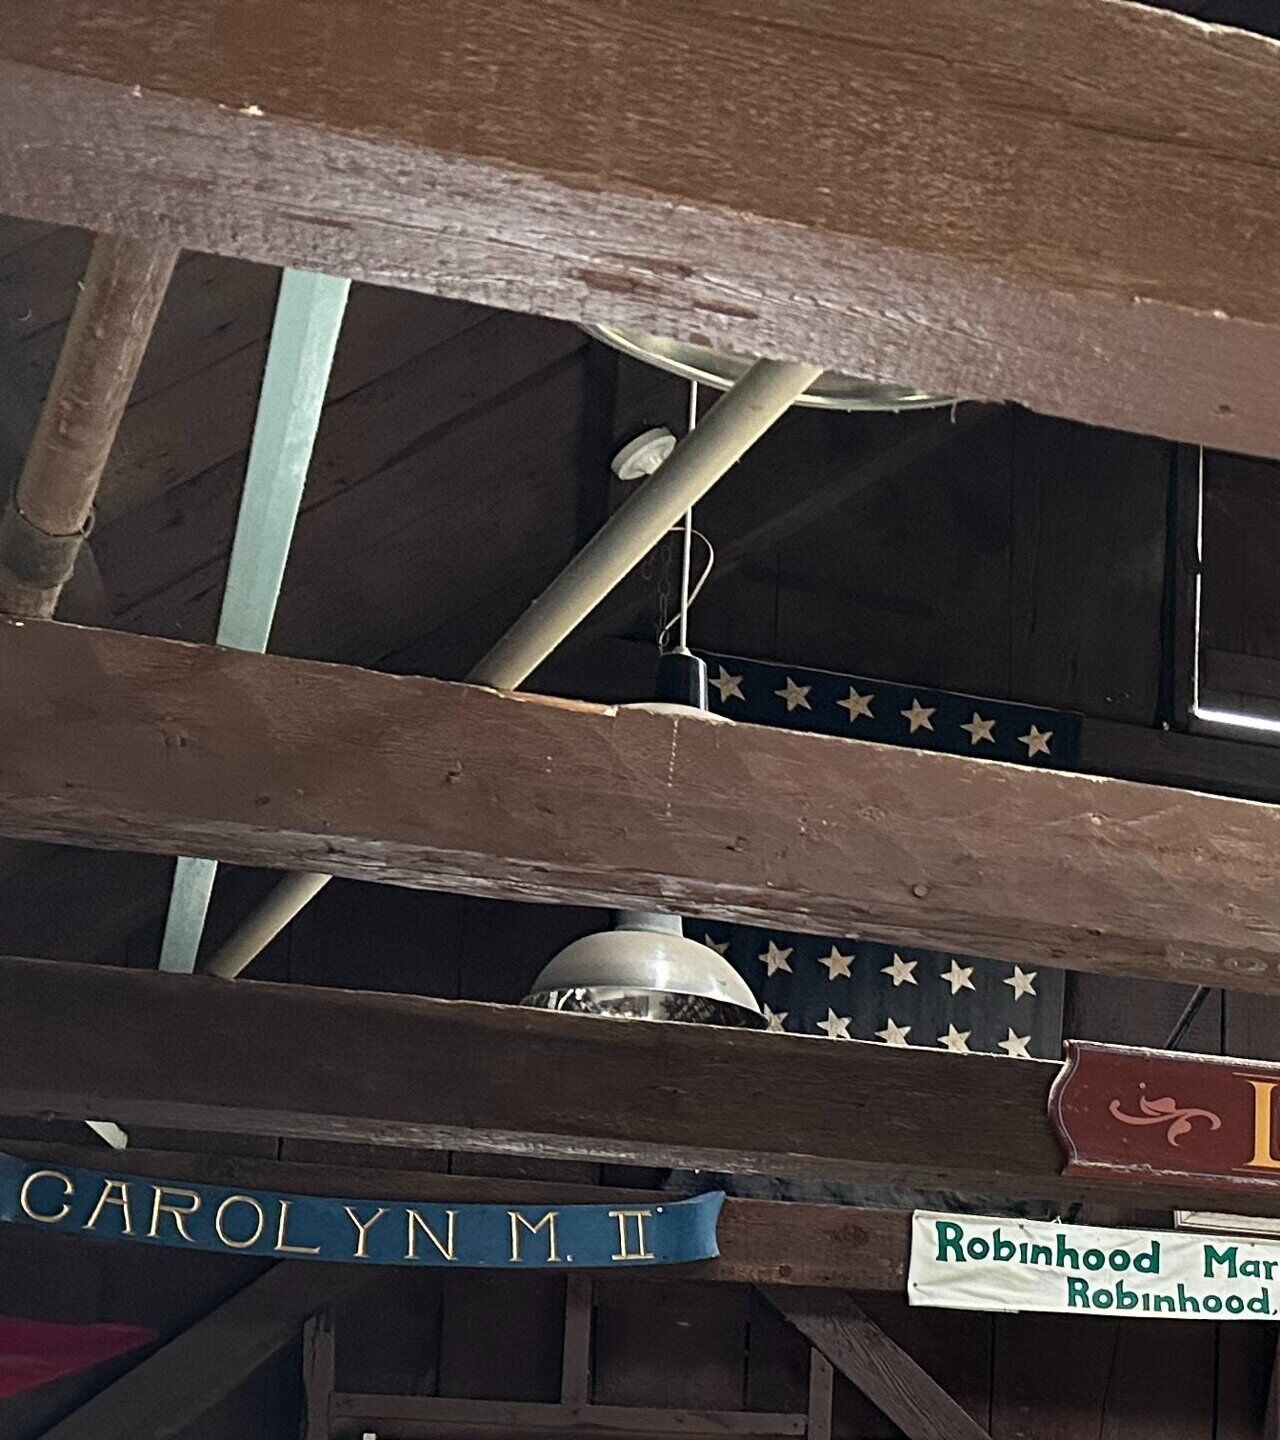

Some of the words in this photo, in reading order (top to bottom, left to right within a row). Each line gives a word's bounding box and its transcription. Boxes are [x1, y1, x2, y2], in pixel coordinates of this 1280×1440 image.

[20, 1169, 458, 1259] CAROLYN
[508, 1210, 573, 1263] M.
[609, 1210, 655, 1260] II
[935, 1220, 1161, 1274] Robinhood
[1067, 1277, 1279, 1316] Robinhood,
